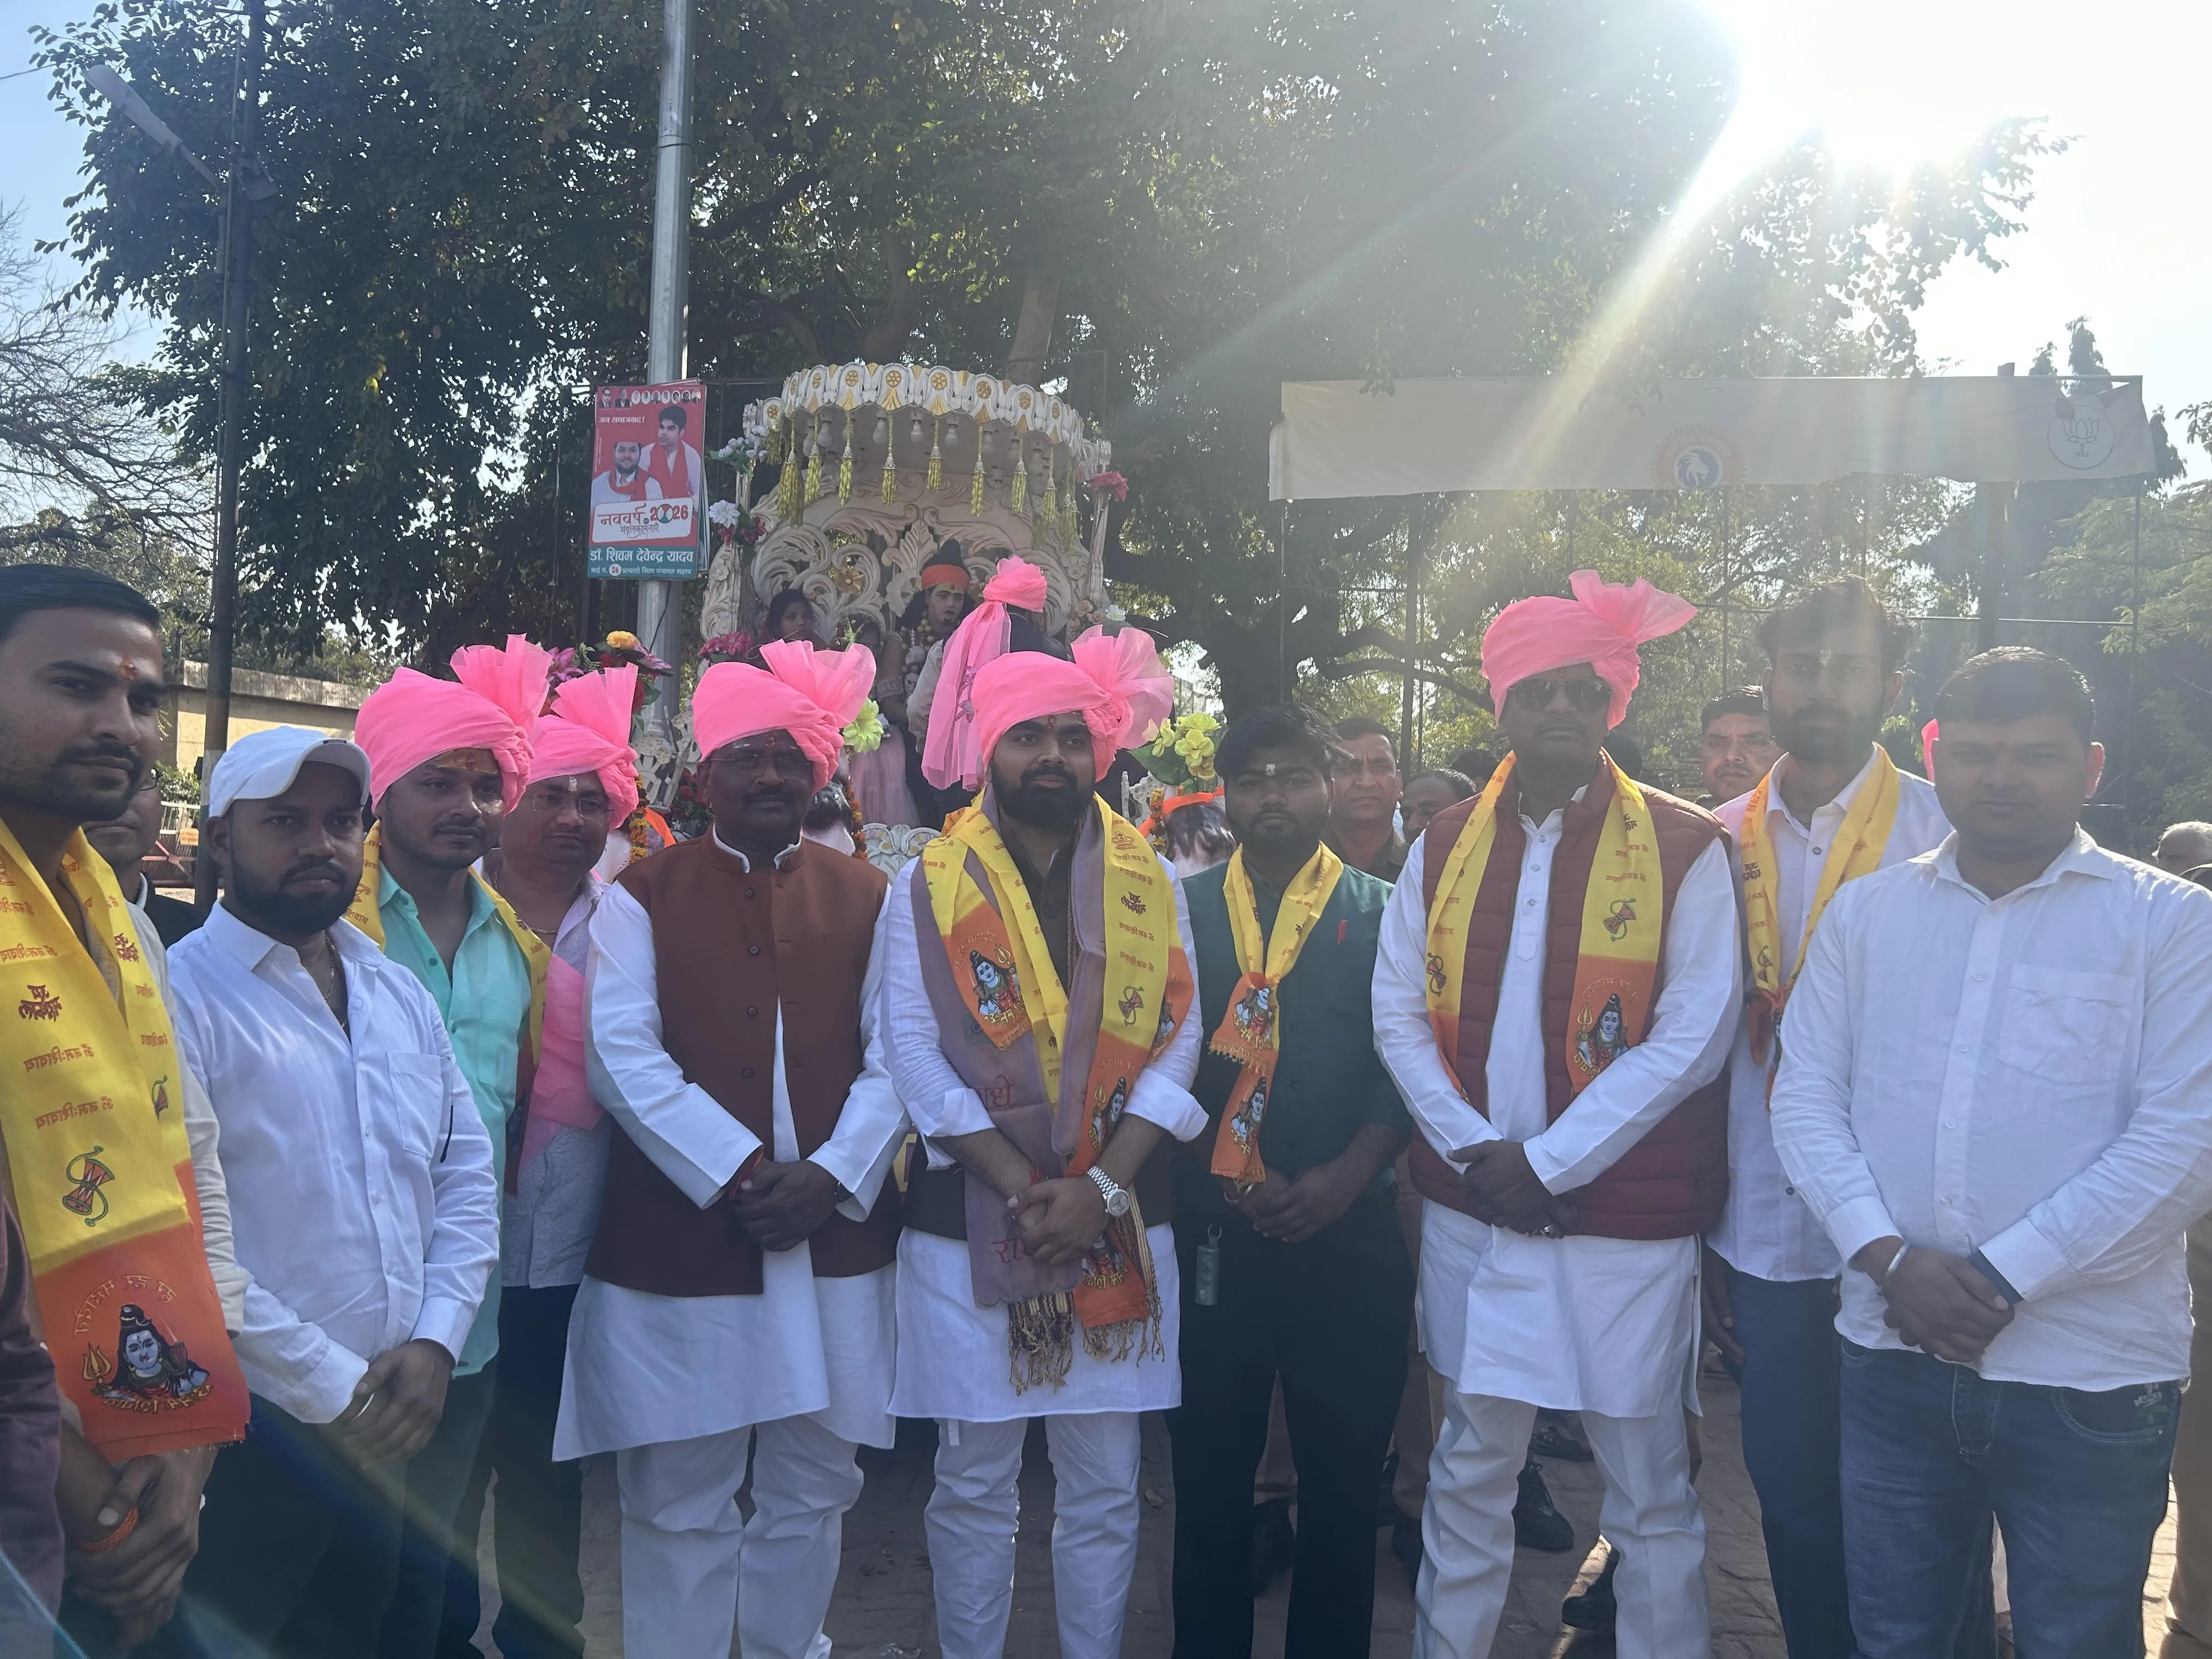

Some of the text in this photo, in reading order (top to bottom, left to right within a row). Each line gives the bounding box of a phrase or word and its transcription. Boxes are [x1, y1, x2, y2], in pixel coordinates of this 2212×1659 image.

[597, 501, 647, 526] नववर्ष
[590, 548, 603, 562] डॉ.
[606, 547, 634, 562] शिवम
[667, 551, 694, 562] यादव
